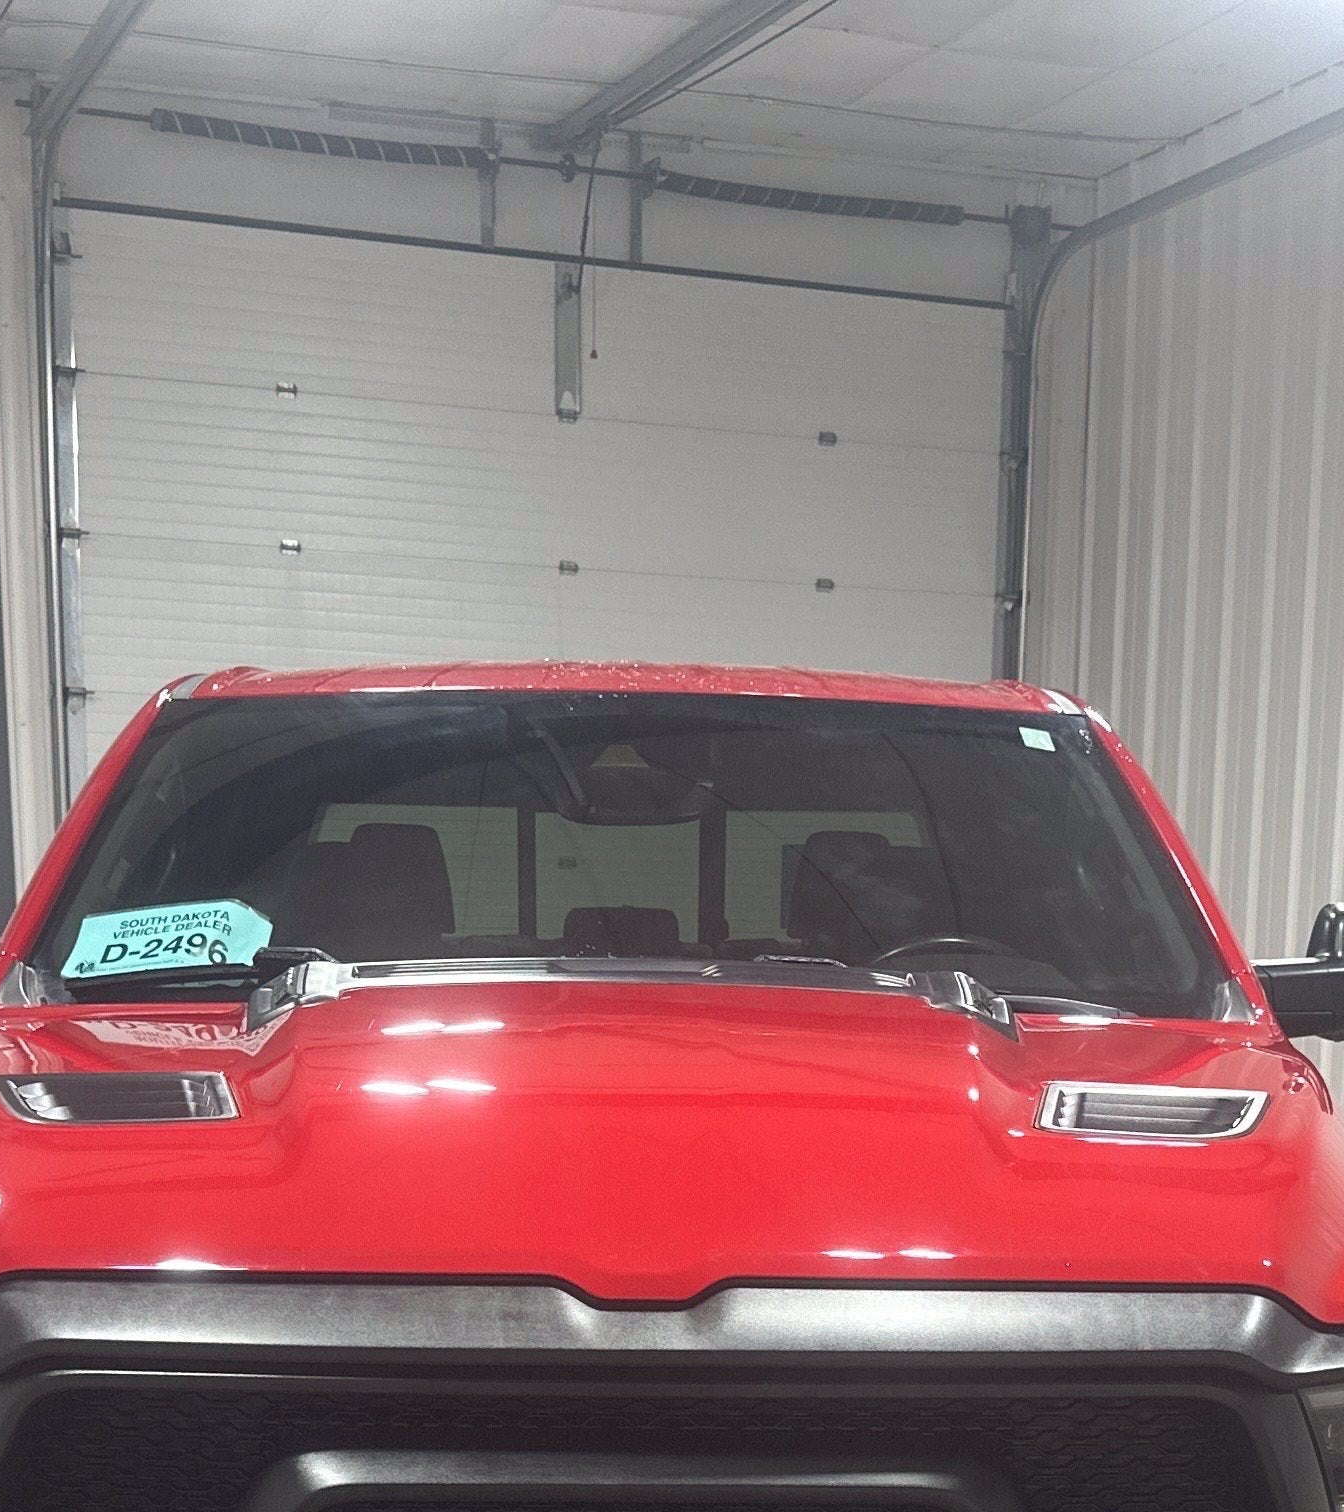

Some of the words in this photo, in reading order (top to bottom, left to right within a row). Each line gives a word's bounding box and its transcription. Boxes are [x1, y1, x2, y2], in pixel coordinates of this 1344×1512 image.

[113, 925, 171, 940] VEHICLE
[174, 919, 232, 936] DEALER
[119, 916, 168, 929] SOUTH
[171, 909, 230, 923] DAKOTA
[99, 932, 229, 964] D-2496
